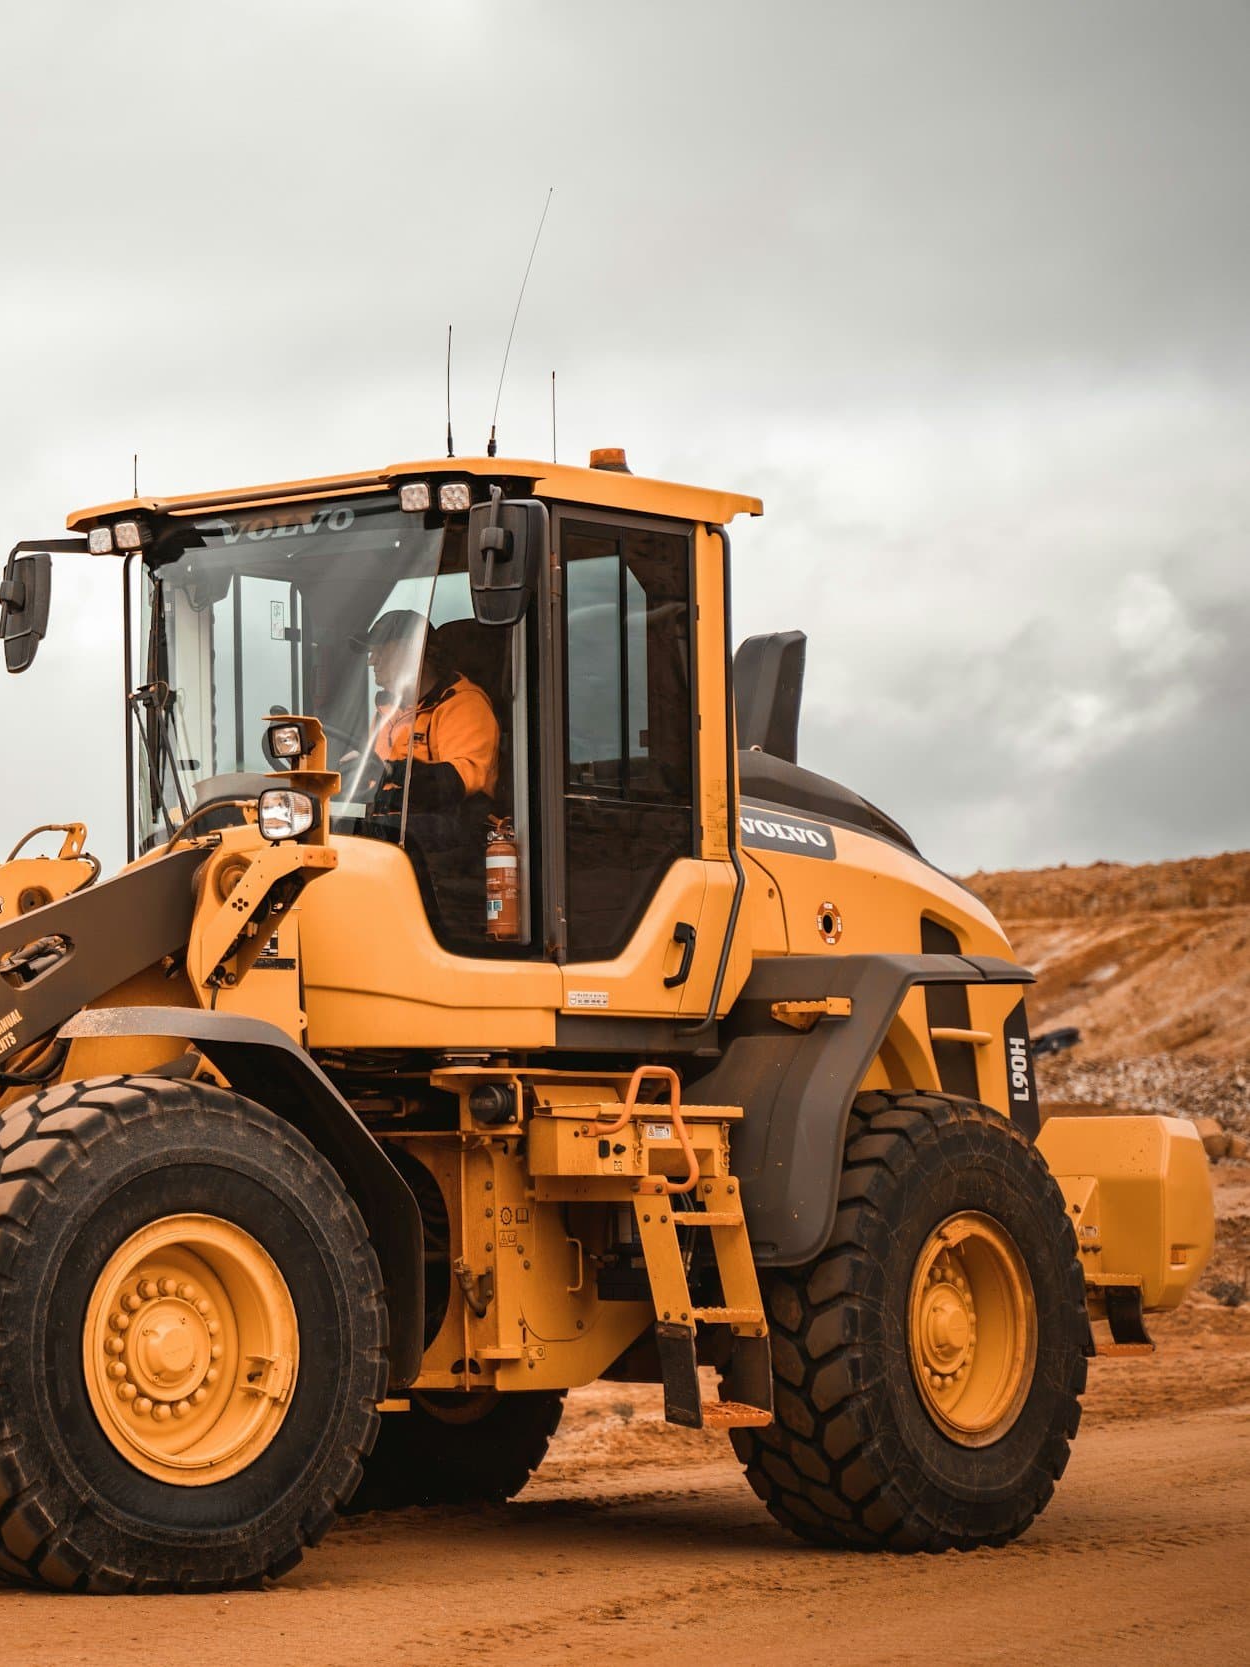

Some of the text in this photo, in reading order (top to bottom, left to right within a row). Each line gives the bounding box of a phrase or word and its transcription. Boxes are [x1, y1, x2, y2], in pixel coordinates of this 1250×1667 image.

[222, 507, 356, 545] VOLVO
[739, 816, 828, 848] VOLVO
[1009, 1037, 1030, 1101] L90H
